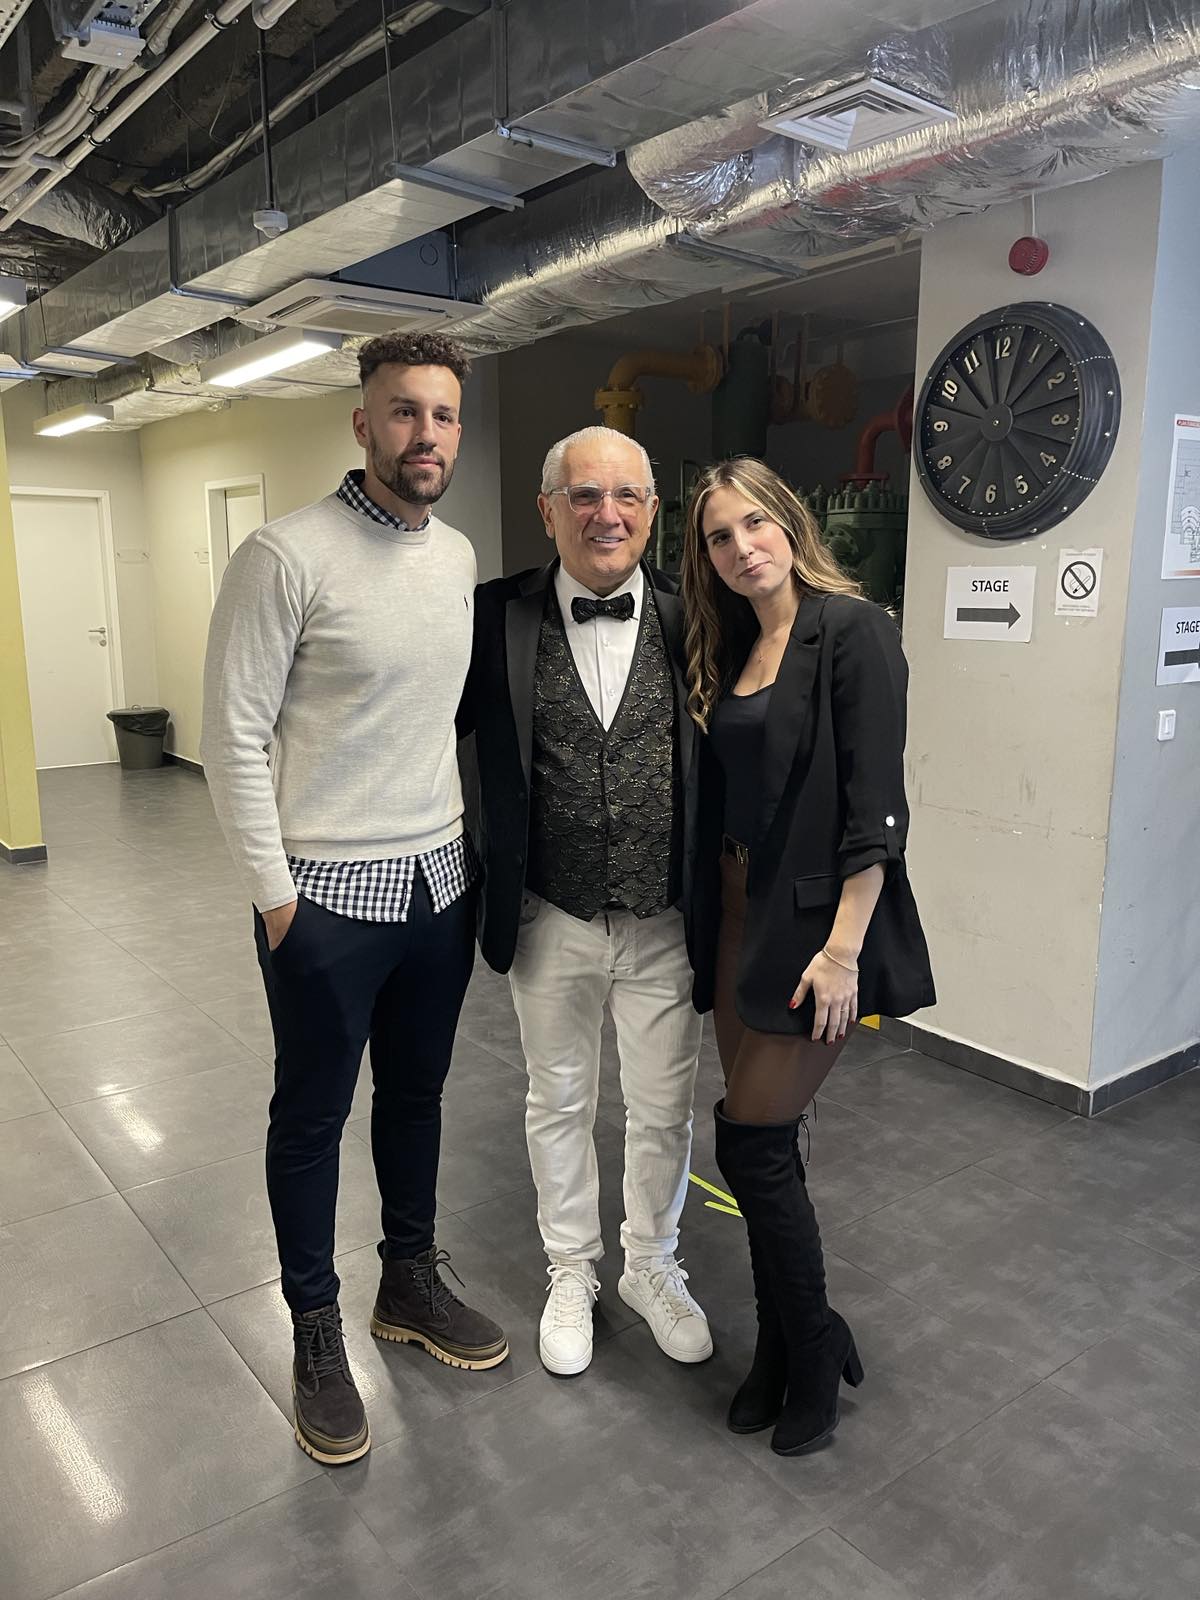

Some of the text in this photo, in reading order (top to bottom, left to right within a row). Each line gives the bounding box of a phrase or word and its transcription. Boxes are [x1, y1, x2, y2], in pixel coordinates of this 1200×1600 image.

[995, 336, 1011, 360] 12
[1028, 343, 1041, 364] 1
[963, 349, 980, 375] 11
[941, 379, 958, 402] 10
[1047, 371, 1065, 391] 2
[933, 420, 949, 432] 9
[1051, 414, 1070, 426] 3
[937, 455, 953, 470] 8
[1039, 451, 1056, 467] 4
[958, 475, 972, 495] 7
[985, 483, 997, 504] 6
[1014, 475, 1029, 495] 5
[971, 580, 1009, 592] STAGE
[1176, 621, 1200, 634] STAGE
